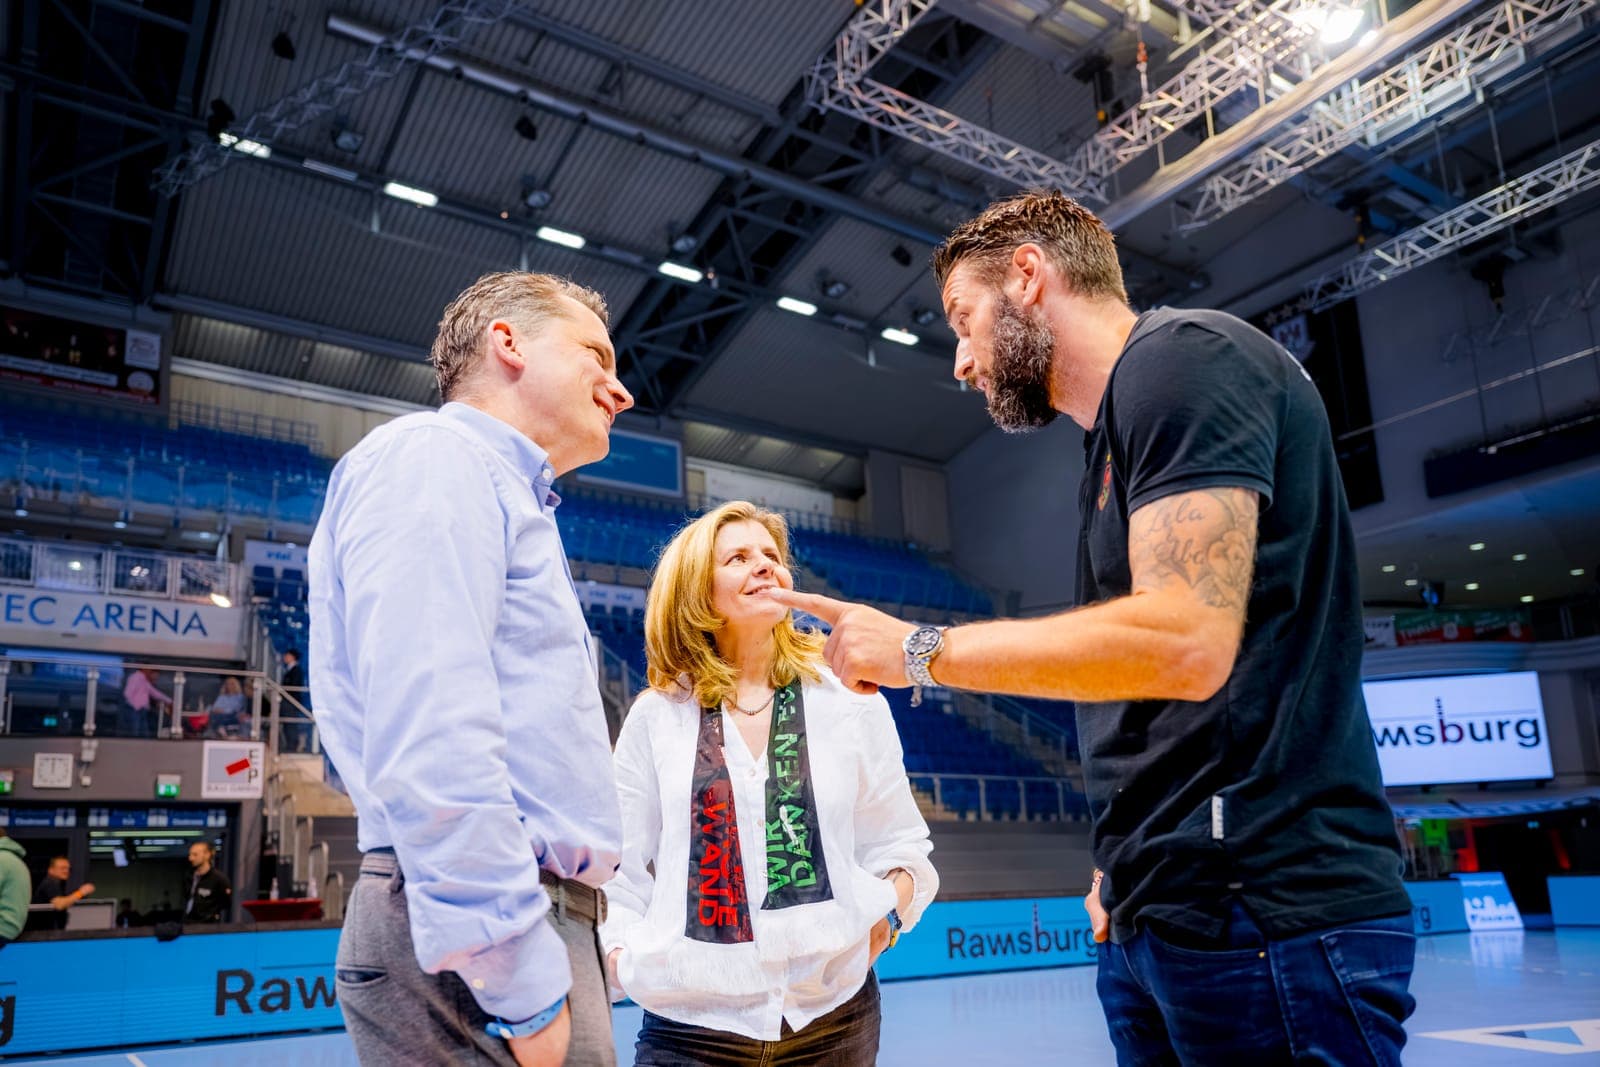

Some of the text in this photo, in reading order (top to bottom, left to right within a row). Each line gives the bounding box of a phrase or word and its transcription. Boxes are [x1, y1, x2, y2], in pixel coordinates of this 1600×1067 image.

[0, 593, 208, 637] EC ARENA
[698, 801, 727, 928] WAND
[766, 819, 791, 893] WIR
